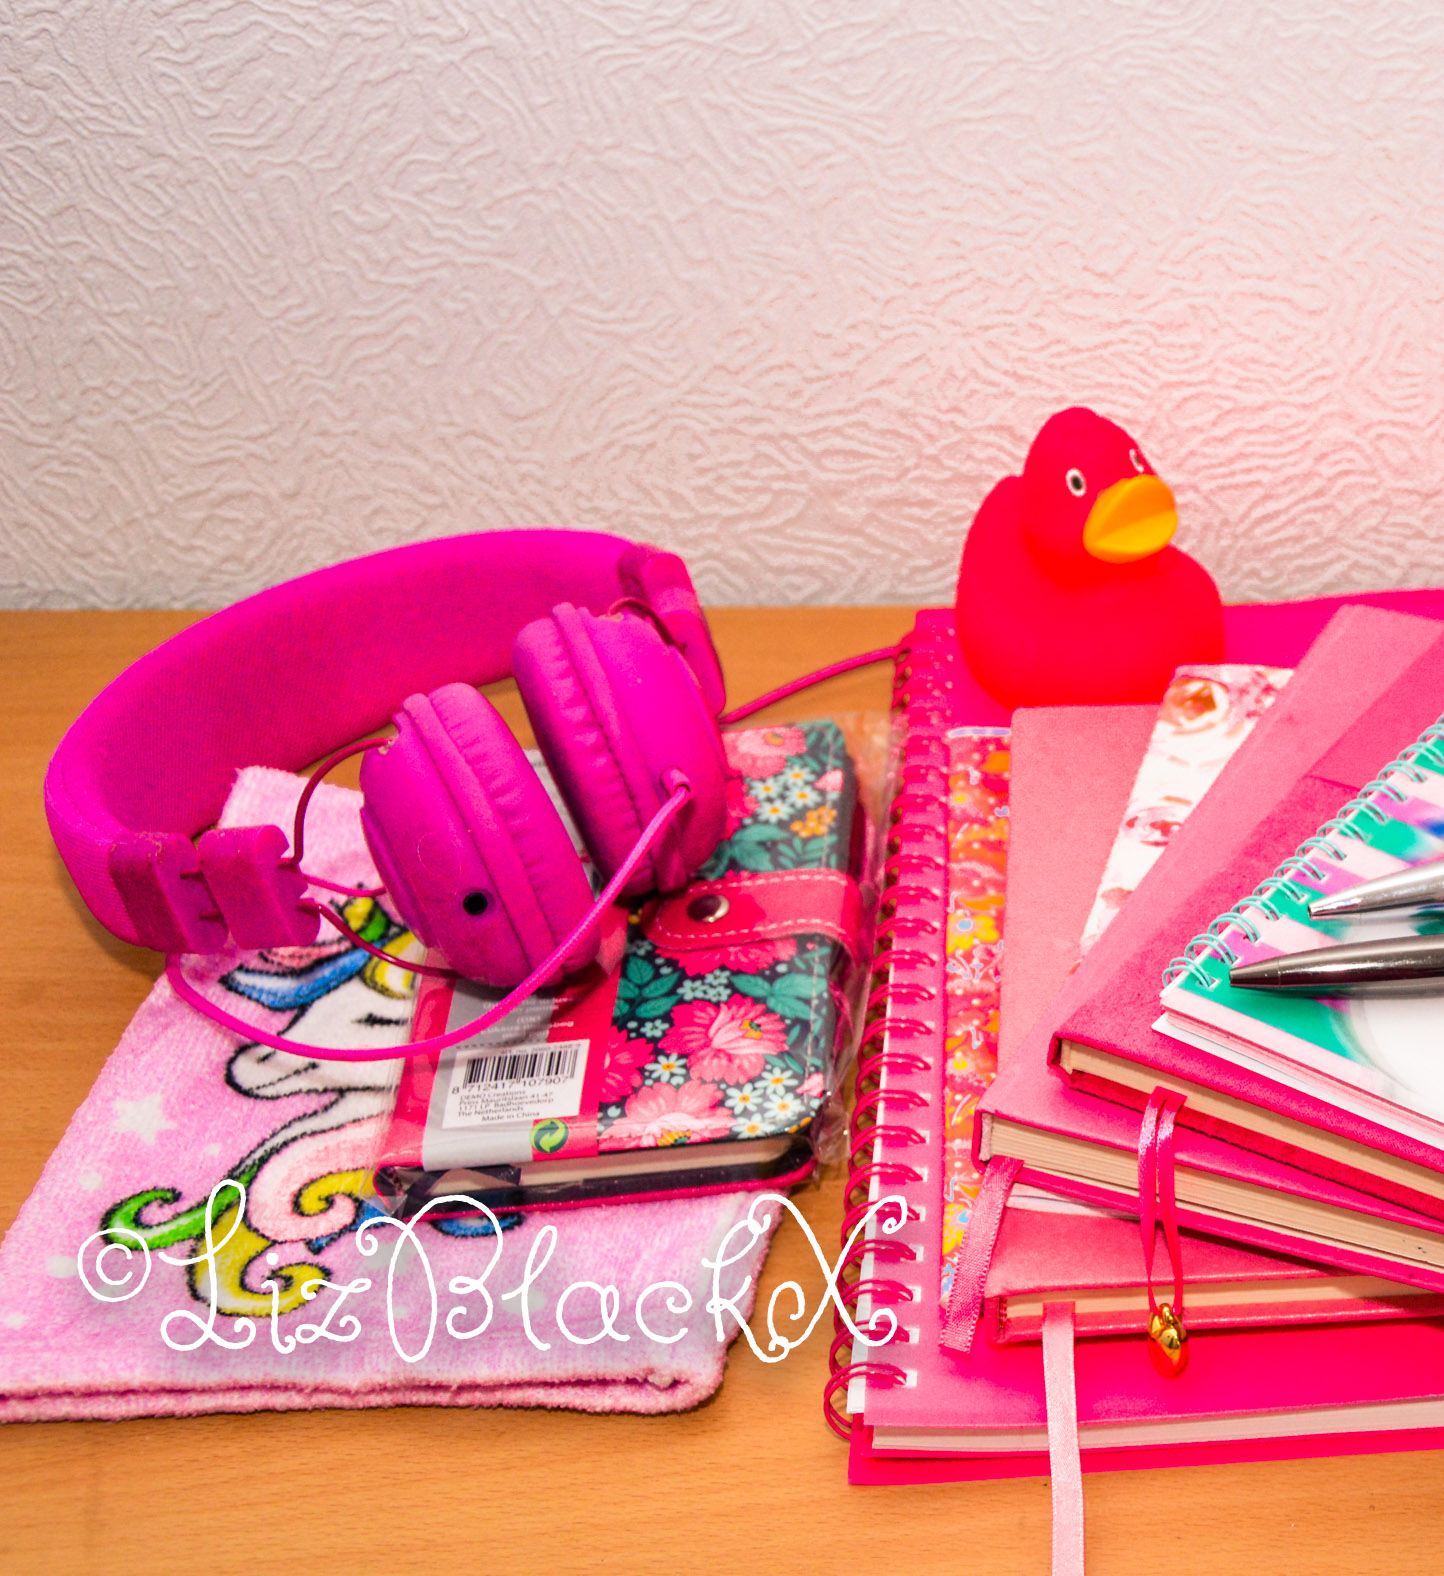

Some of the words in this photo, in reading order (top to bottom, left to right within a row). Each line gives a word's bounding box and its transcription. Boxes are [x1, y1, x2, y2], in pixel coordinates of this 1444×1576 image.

[451, 1086, 460, 1095] 8
[467, 1082, 516, 1092] 712417
[522, 1076, 569, 1087] 107907
